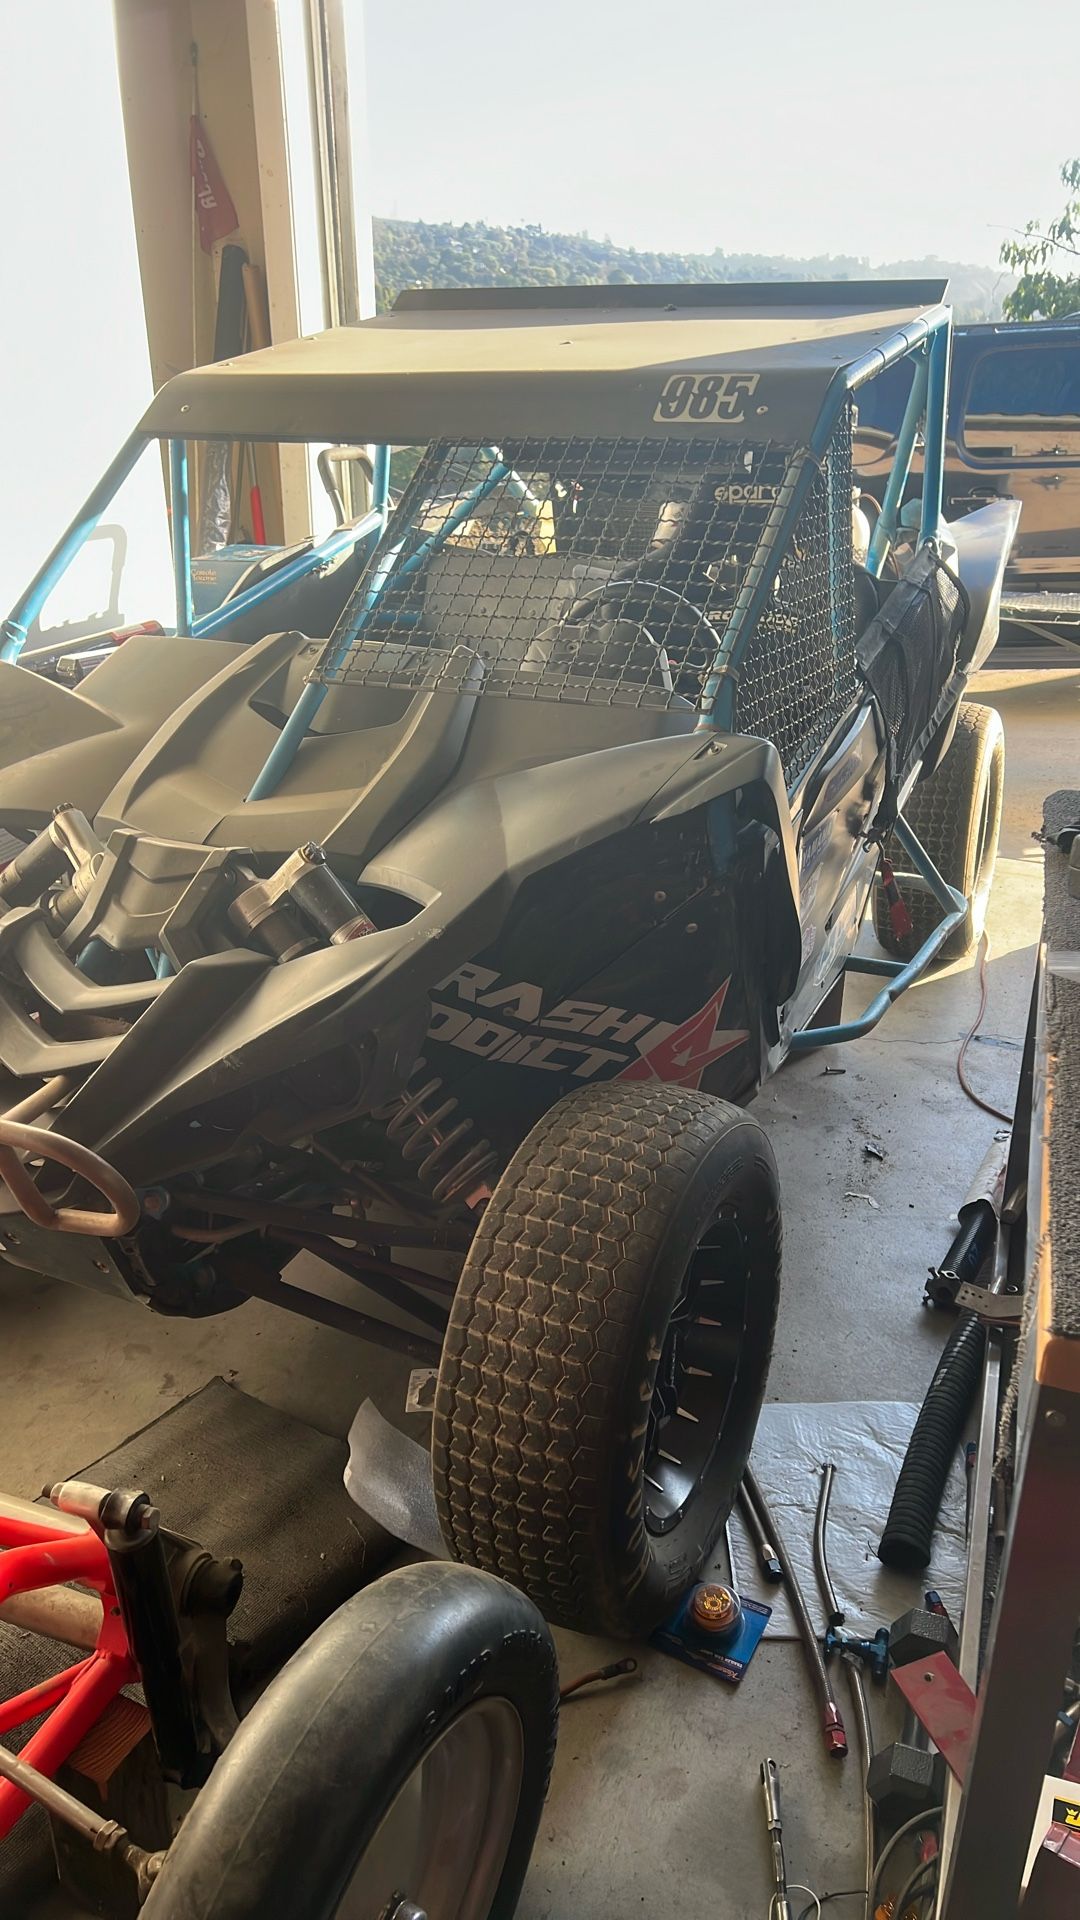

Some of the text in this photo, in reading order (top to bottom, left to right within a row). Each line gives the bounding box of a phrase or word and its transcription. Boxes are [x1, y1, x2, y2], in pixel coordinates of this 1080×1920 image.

[658, 375, 755, 420] 985
[714, 484, 781, 504] sparc
[432, 961, 655, 1044] RASH
[426, 1001, 630, 1078] DDICT
